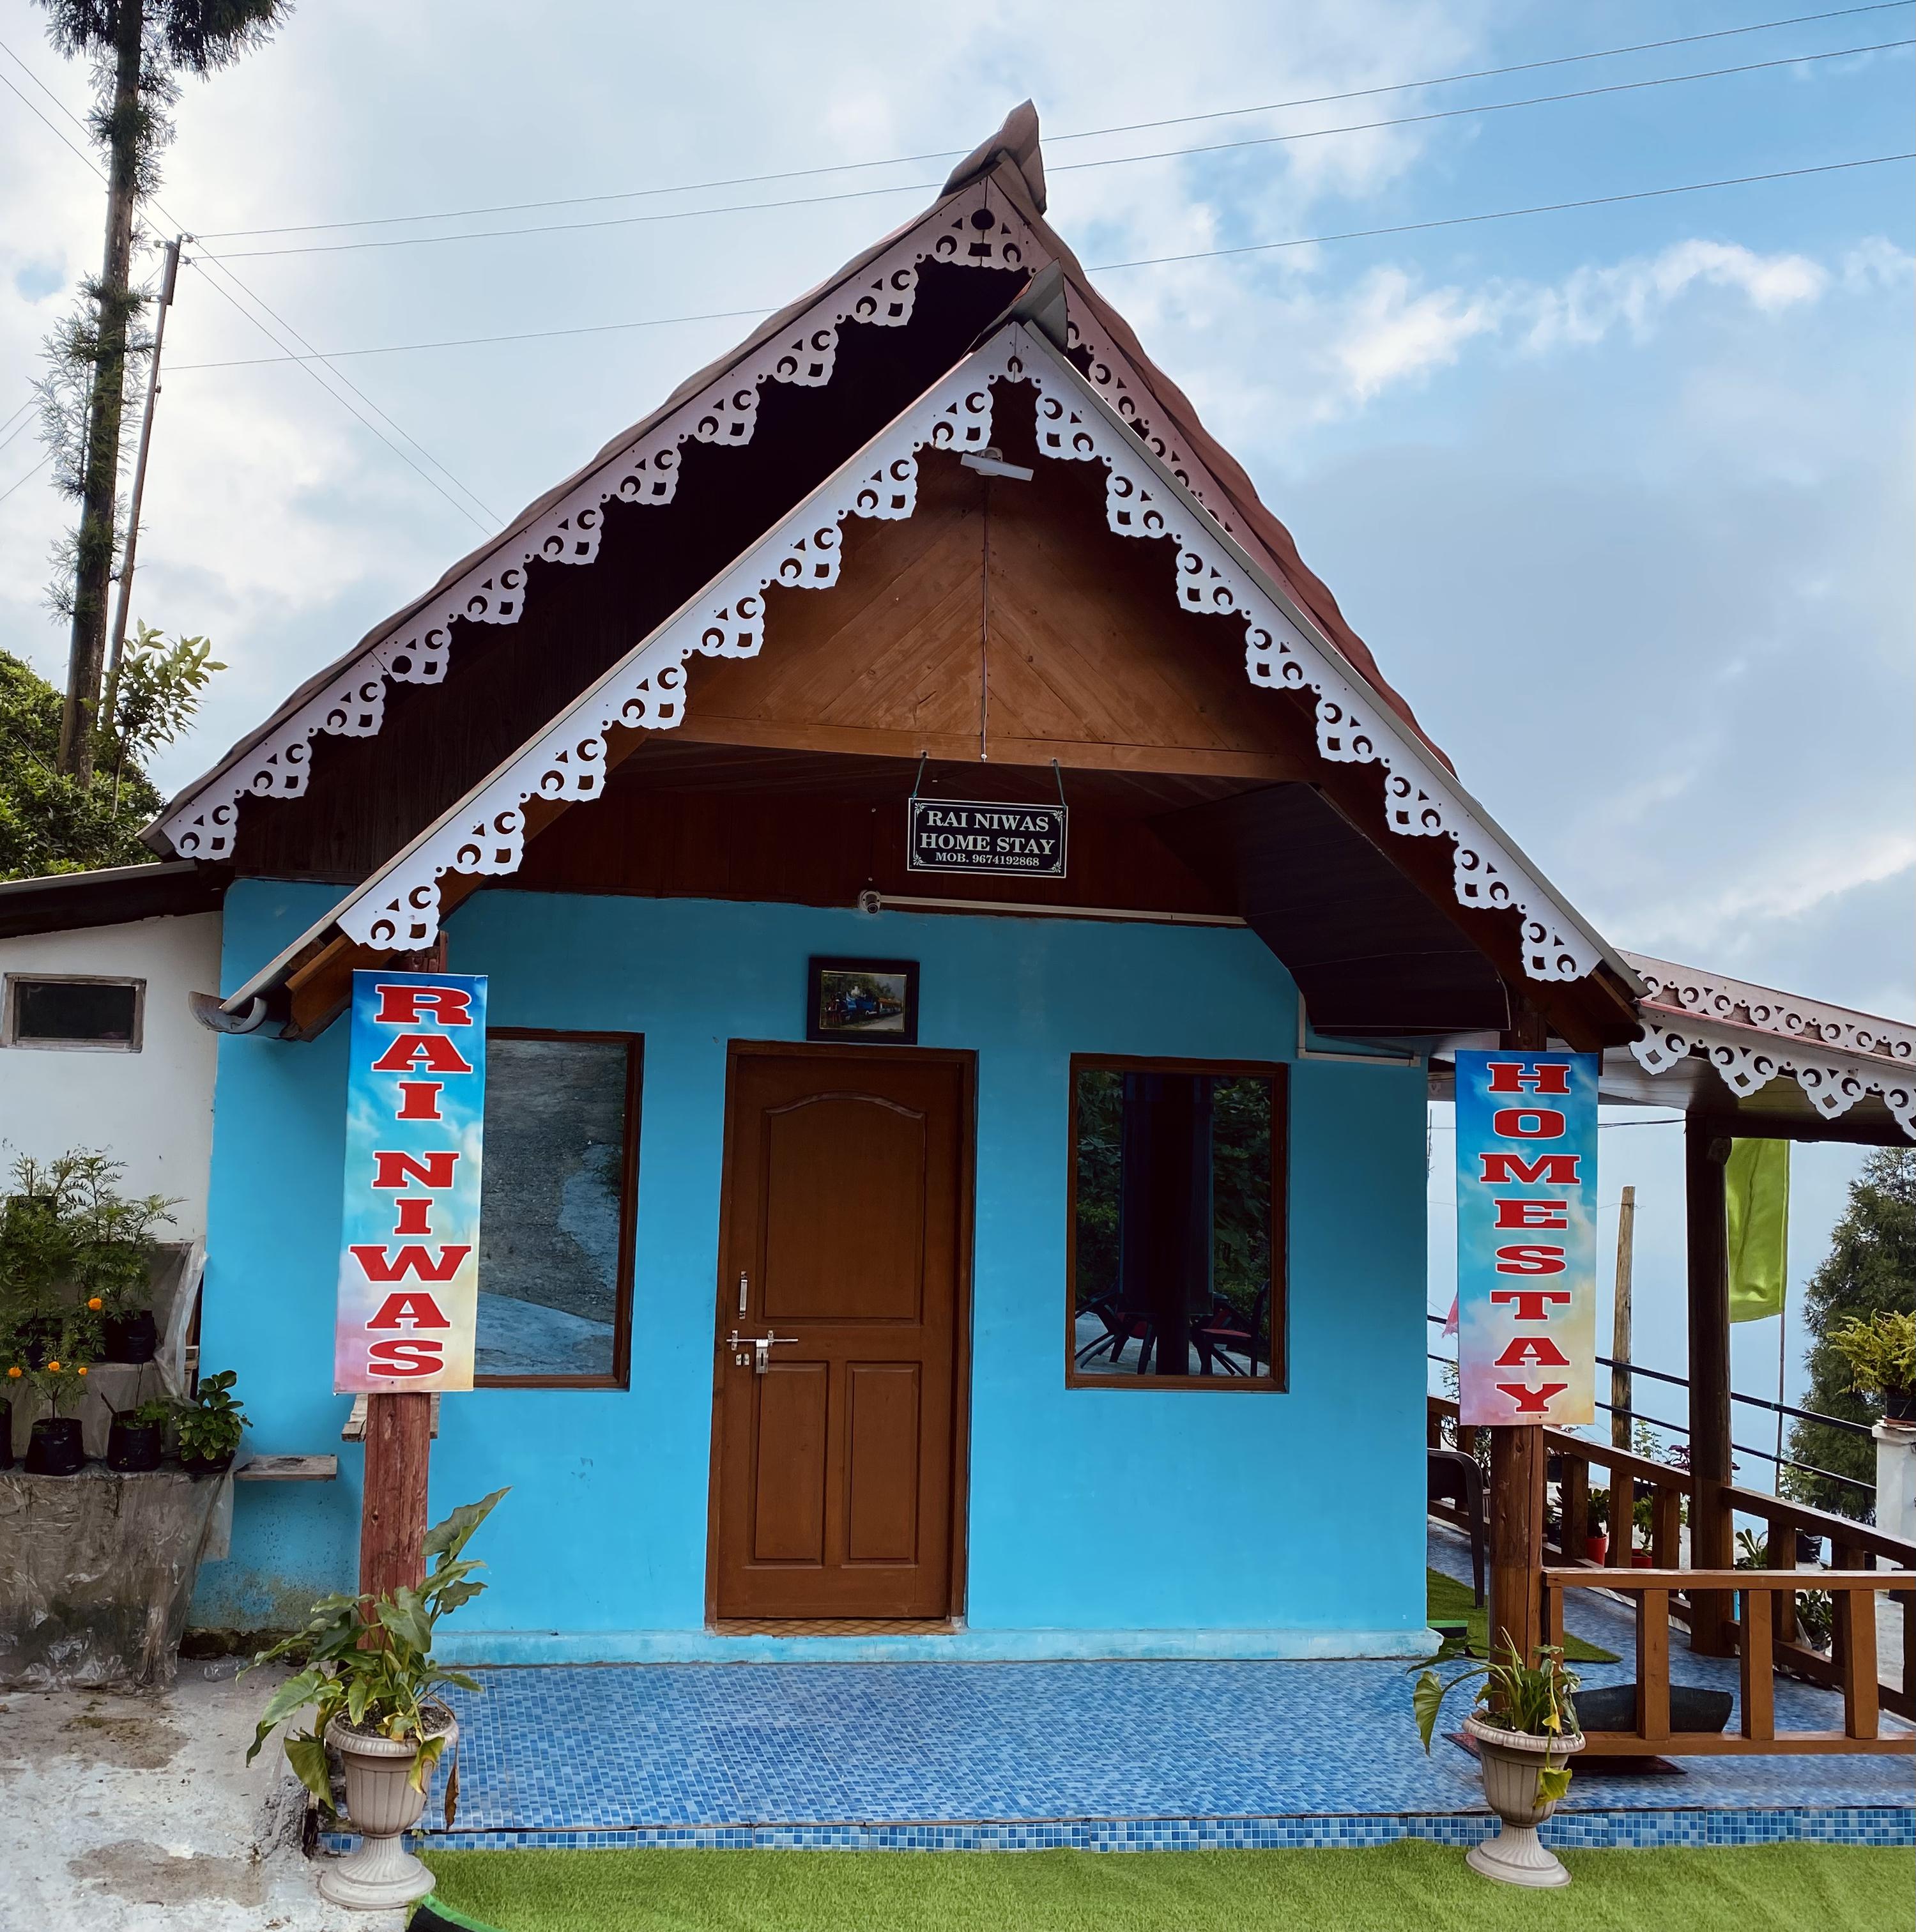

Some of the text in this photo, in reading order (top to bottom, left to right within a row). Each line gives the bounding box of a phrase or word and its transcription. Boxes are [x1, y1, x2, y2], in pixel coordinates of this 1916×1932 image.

[926, 810, 1049, 832] RAI NIWAS
[920, 832, 1055, 854] HOME STAY
[935, 852, 1039, 866] MOB. 9674192868
[348, 985, 473, 1378] RAI NIWAS
[1478, 1062, 1581, 1414] HOMESTAY
